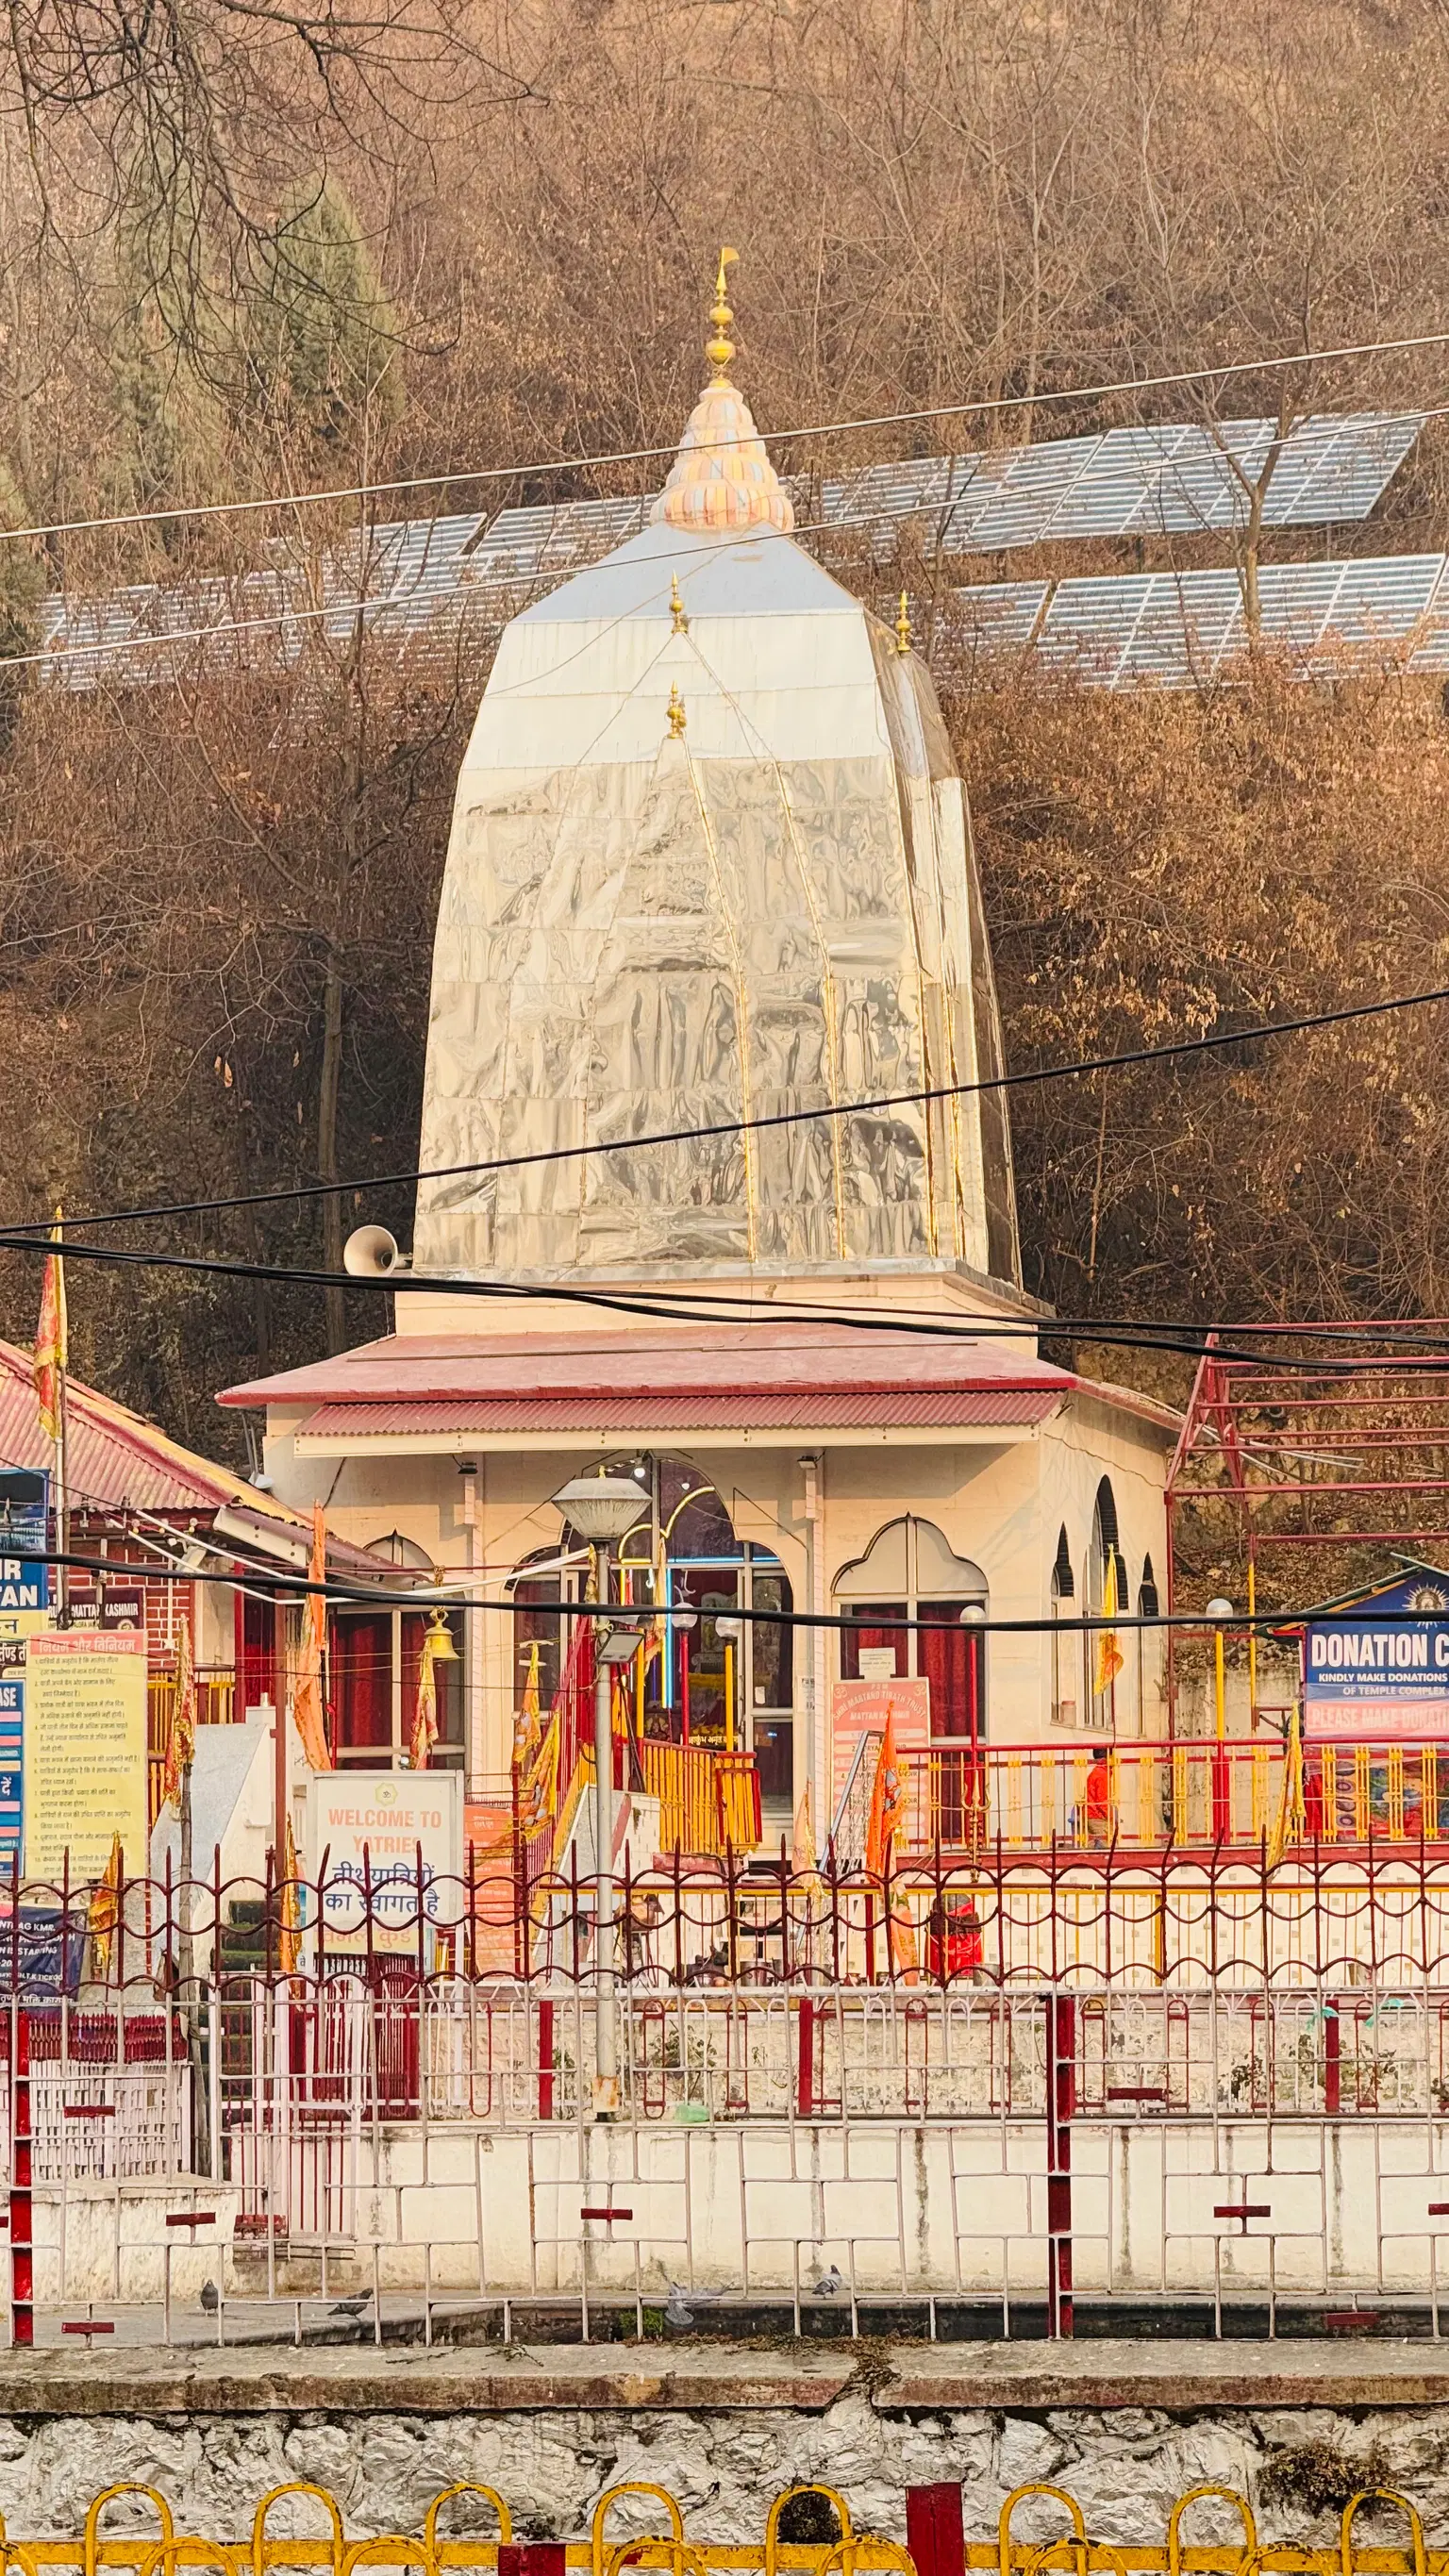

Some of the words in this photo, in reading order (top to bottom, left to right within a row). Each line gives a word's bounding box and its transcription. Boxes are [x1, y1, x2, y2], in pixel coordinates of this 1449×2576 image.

[0, 1585, 38, 1606] AN
[1311, 1634, 1428, 1667] DONATION
[1319, 1672, 1356, 1683] KINDLY
[1357, 1672, 1387, 1683] MAKE
[1388, 1672, 1448, 1683] DONATIONS
[1343, 1687, 1357, 1696] OF
[1358, 1687, 1396, 1696] TEMPLE
[1398, 1686, 1446, 1696] COMPLEX
[907, 1698, 926, 1719] TRUST
[1312, 1708, 1358, 1729] PLEASE
[328, 1808, 415, 1828] WELCOME
[420, 1810, 441, 1828] TO
[332, 1861, 435, 1887] तीथयात्रियों
[325, 1893, 352, 1912] का
[425, 1888, 441, 1917] है
